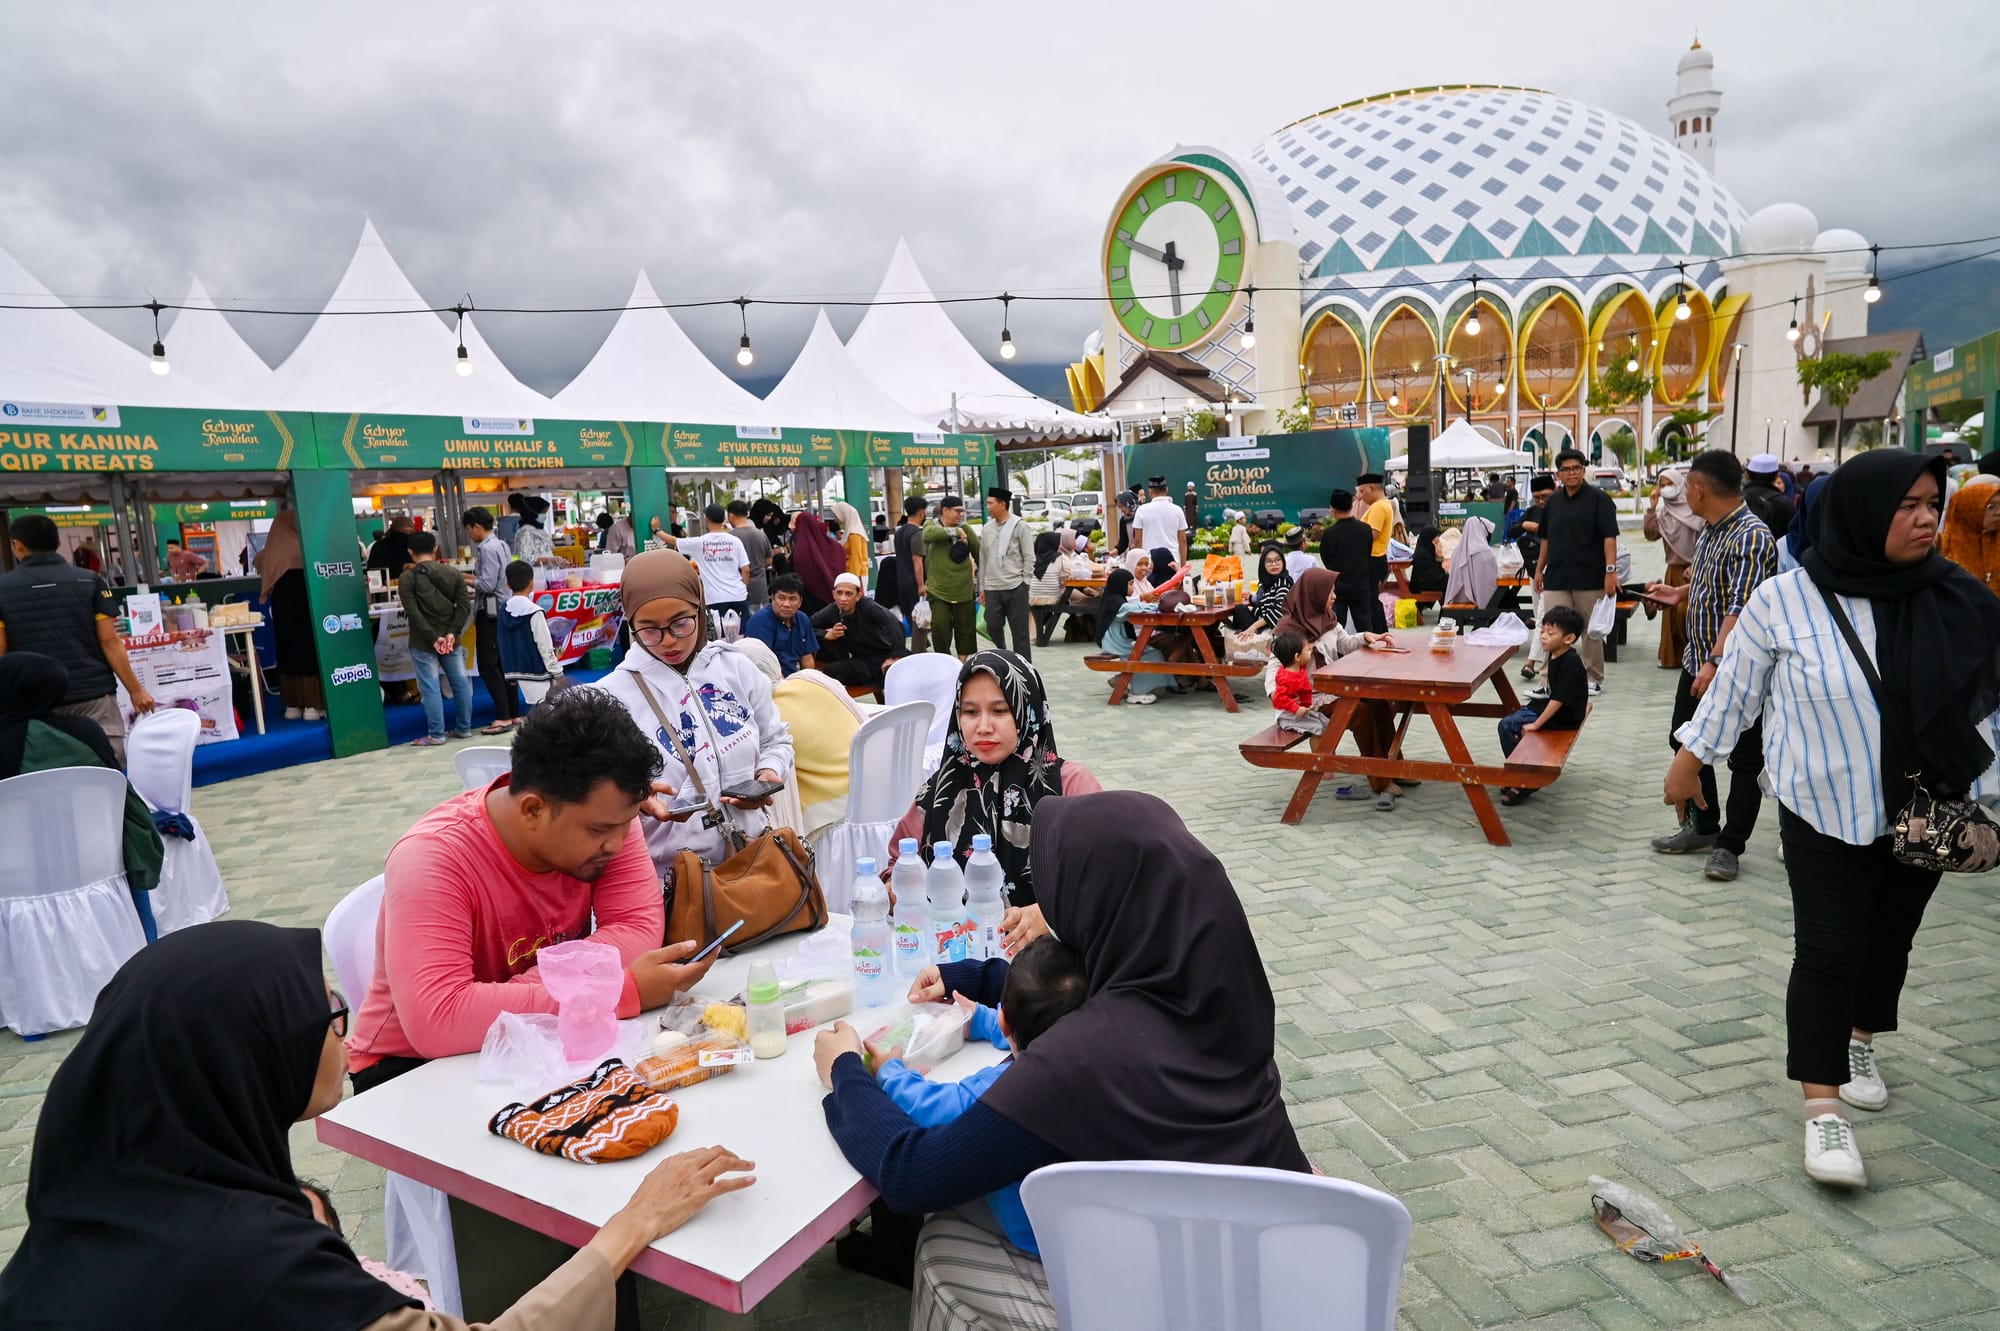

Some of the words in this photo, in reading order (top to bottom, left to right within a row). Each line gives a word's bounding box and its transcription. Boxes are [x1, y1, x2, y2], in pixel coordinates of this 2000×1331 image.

[202, 419, 254, 436] Gebyar
[363, 424, 405, 440] Gebyar
[59, 433, 159, 450] KANINA
[202, 433, 260, 447] Ramadan
[363, 437, 408, 448] Ramadan
[445, 440, 489, 452] UMMU
[494, 440, 543, 453] KHALIF
[548, 441, 557, 453] &
[717, 442, 748, 453] JEYUK
[751, 443, 779, 453] PEYAS
[782, 444, 802, 454] PALU
[931, 448, 958, 456] KITCHEN
[55, 454, 154, 471] TREATS
[442, 457, 501, 469] AUREL'S
[506, 457, 564, 469] KITCHEN
[724, 456, 731, 466] &
[733, 456, 775, 466] NANDIKA
[778, 457, 800, 466] FOOD
[911, 458, 933, 466] DAPUR
[935, 458, 959, 466] YASMIN
[1207, 464, 1270, 485] Gebyar
[1204, 481, 1274, 500] Ramadan
[316, 563, 353, 578] QRIS
[557, 591, 580, 612] ES
[130, 633, 170, 647] TREATS
[855, 965, 881, 974] Minerale
[862, 960, 870, 968] Le
